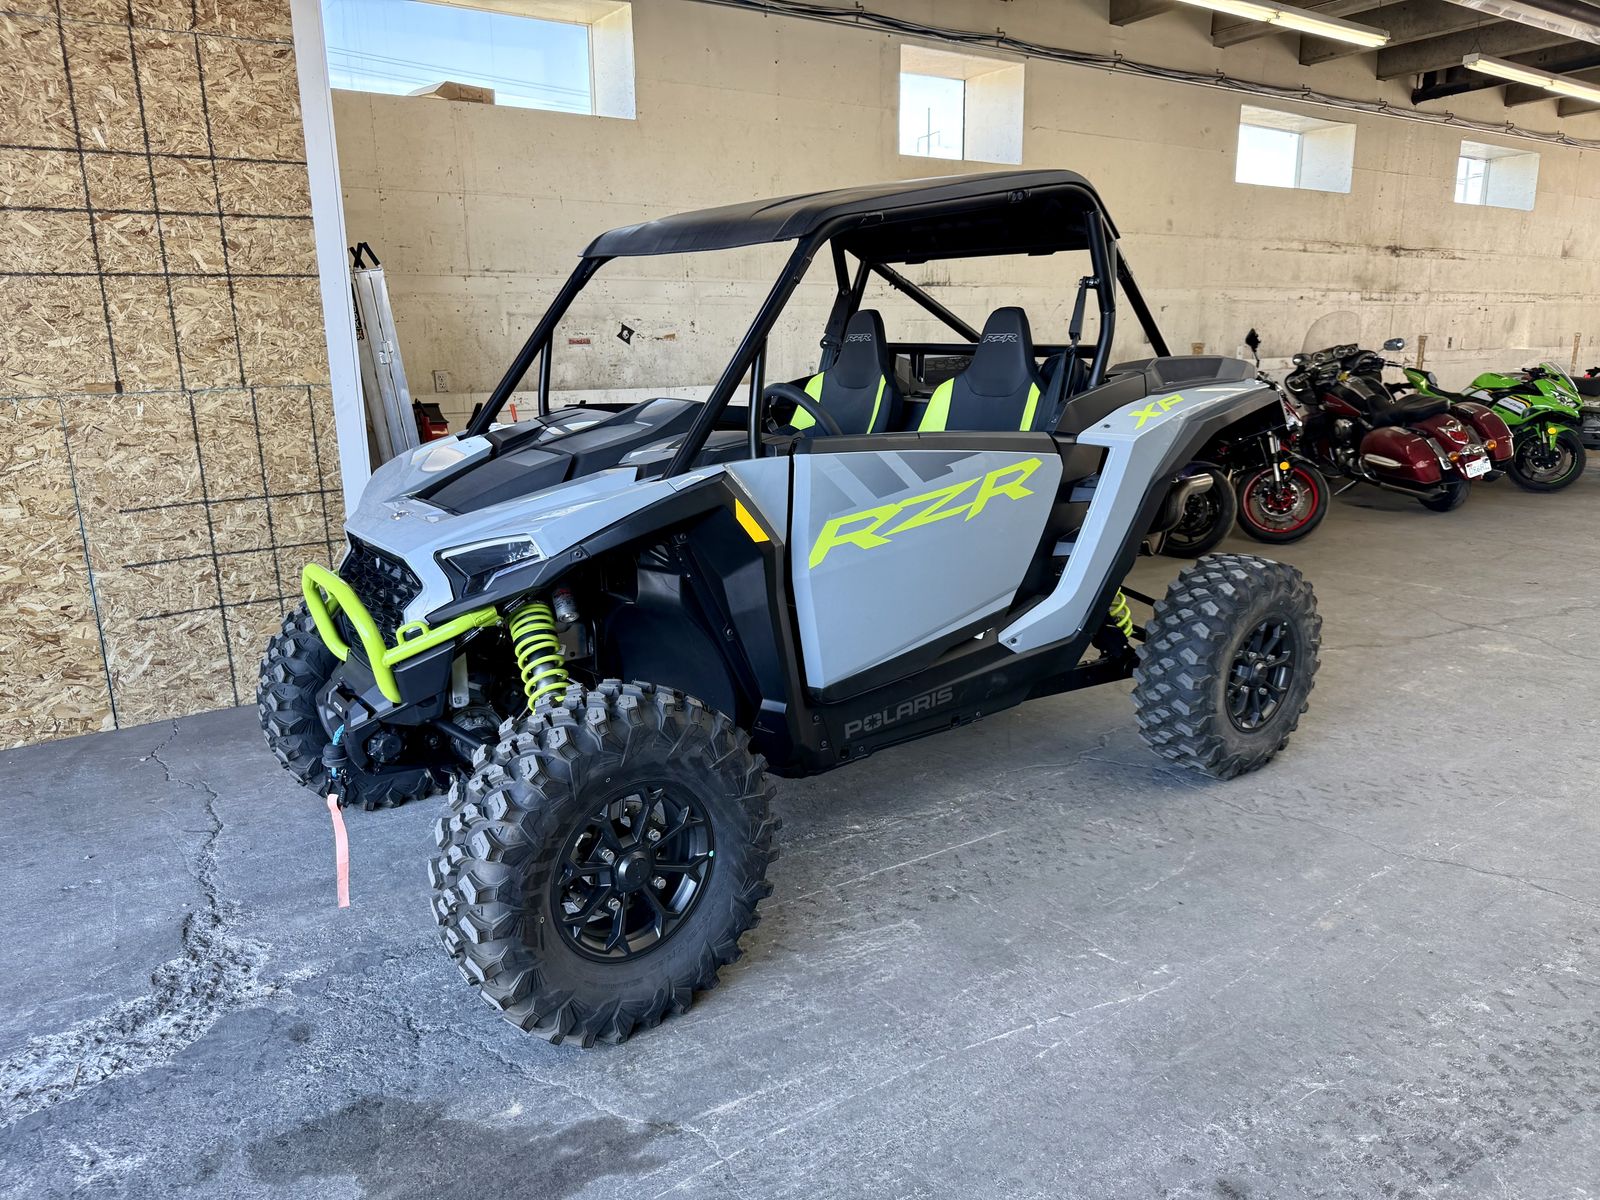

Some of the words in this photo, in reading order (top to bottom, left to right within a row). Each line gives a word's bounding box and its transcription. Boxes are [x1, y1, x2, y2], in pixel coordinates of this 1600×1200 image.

[845, 333, 872, 343] RZR
[982, 333, 1018, 343] RZR
[1128, 394, 1184, 430] XP
[809, 457, 1043, 570] RZR
[844, 686, 953, 739] POLARIS
